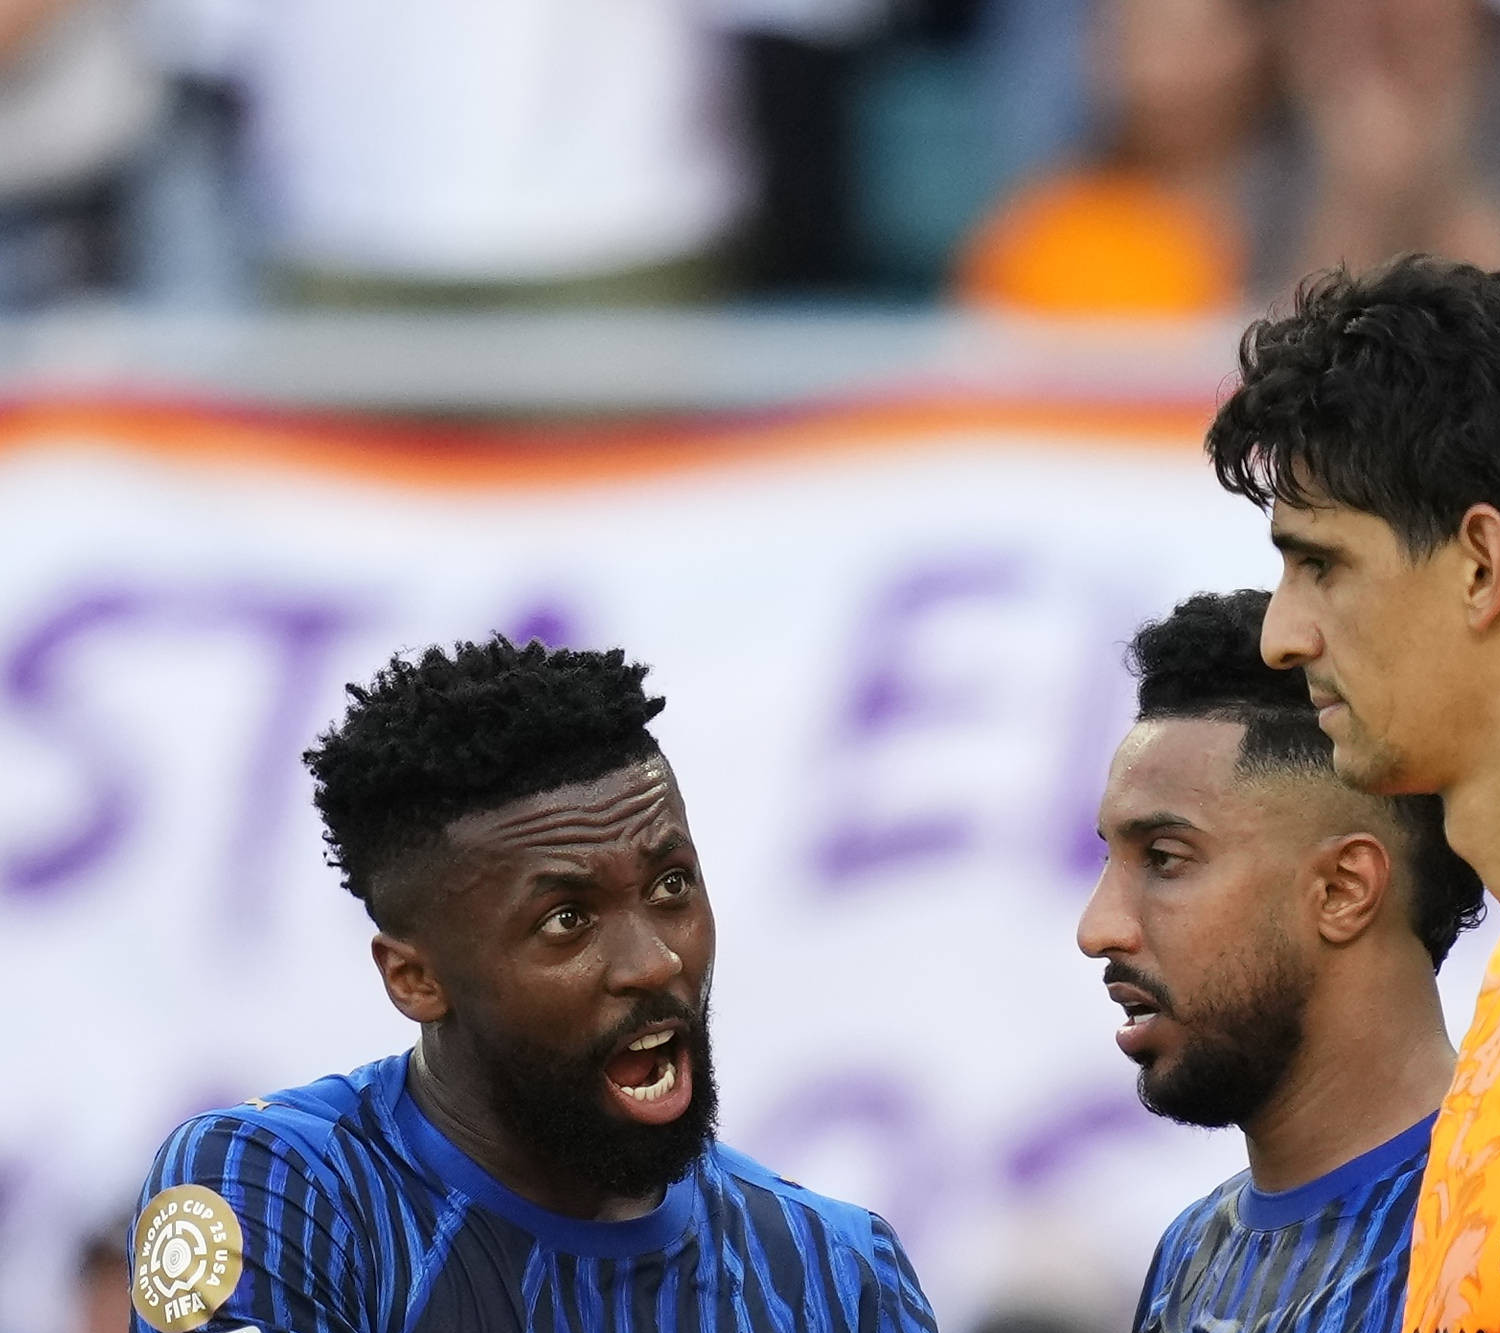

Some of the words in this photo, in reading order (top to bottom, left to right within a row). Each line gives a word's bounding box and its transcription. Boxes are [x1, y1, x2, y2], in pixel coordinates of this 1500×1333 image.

[182, 1199, 214, 1220] CUP
[142, 1202, 178, 1257] WORLD
[209, 1221, 227, 1243] 25
[139, 1263, 160, 1308] CLUB
[206, 1249, 228, 1287] USA
[164, 1291, 206, 1324] FIFA
